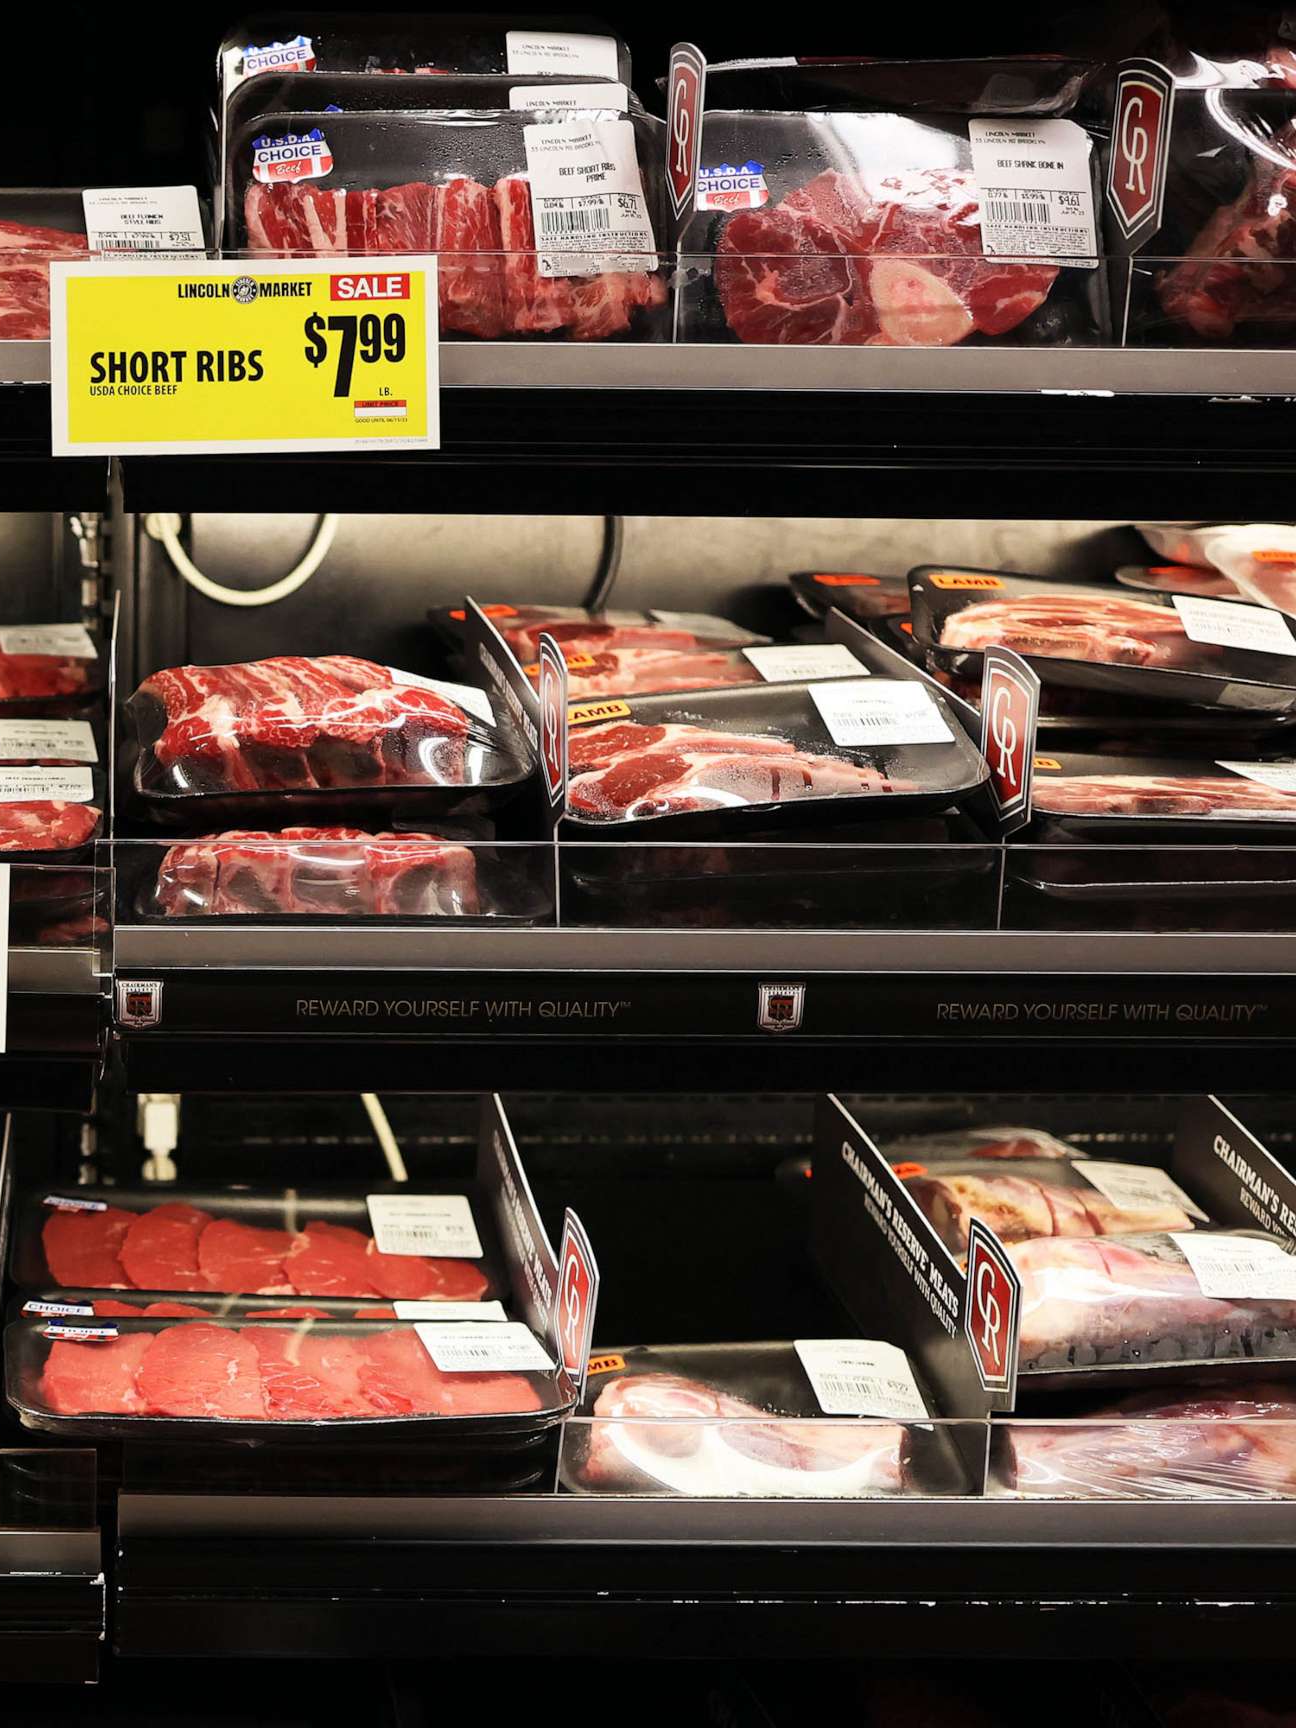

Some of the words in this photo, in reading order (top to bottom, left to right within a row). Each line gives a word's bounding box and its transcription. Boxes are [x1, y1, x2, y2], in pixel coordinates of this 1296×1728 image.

[247, 49, 307, 70] CHOICE
[261, 135, 315, 147] U.S.D.A.
[258, 145, 322, 163] CHOICE
[276, 162, 302, 174] Beef
[558, 166, 575, 175] BEEF
[576, 164, 599, 174] SHORT
[699, 167, 754, 178] U.S.D.A.
[697, 178, 761, 192] CHOICE
[713, 193, 739, 206] Beef
[178, 283, 230, 298] LINCOLN
[259, 282, 312, 297] MARKET
[337, 276, 402, 299] SALE
[90, 351, 186, 384] SHORT
[197, 350, 264, 383] RIBS
[90, 386, 115, 396] USDA
[117, 385, 153, 396] CHOICE
[155, 385, 178, 395] BEEF
[379, 387, 392, 396] LB.
[568, 704, 622, 721] AMB
[297, 999, 380, 1017] REWARD
[383, 1000, 480, 1017] YOURSELF
[485, 1000, 534, 1017] WITH
[937, 1003, 1020, 1020] REWARD
[1024, 1003, 1120, 1021] YOURSELF
[1124, 1004, 1170, 1021] WITH
[1214, 1135, 1280, 1214] CHAIRMAN'S
[1240, 1186, 1271, 1230] REWARD
[841, 1141, 892, 1219] CHAIRMAN'S
[891, 1207, 930, 1271] RESERVE
[929, 1262, 959, 1318] MEATS
[28, 1303, 85, 1314] CHOICE
[913, 1266, 930, 1302] WITH
[930, 1293, 958, 1340] QUALITY
